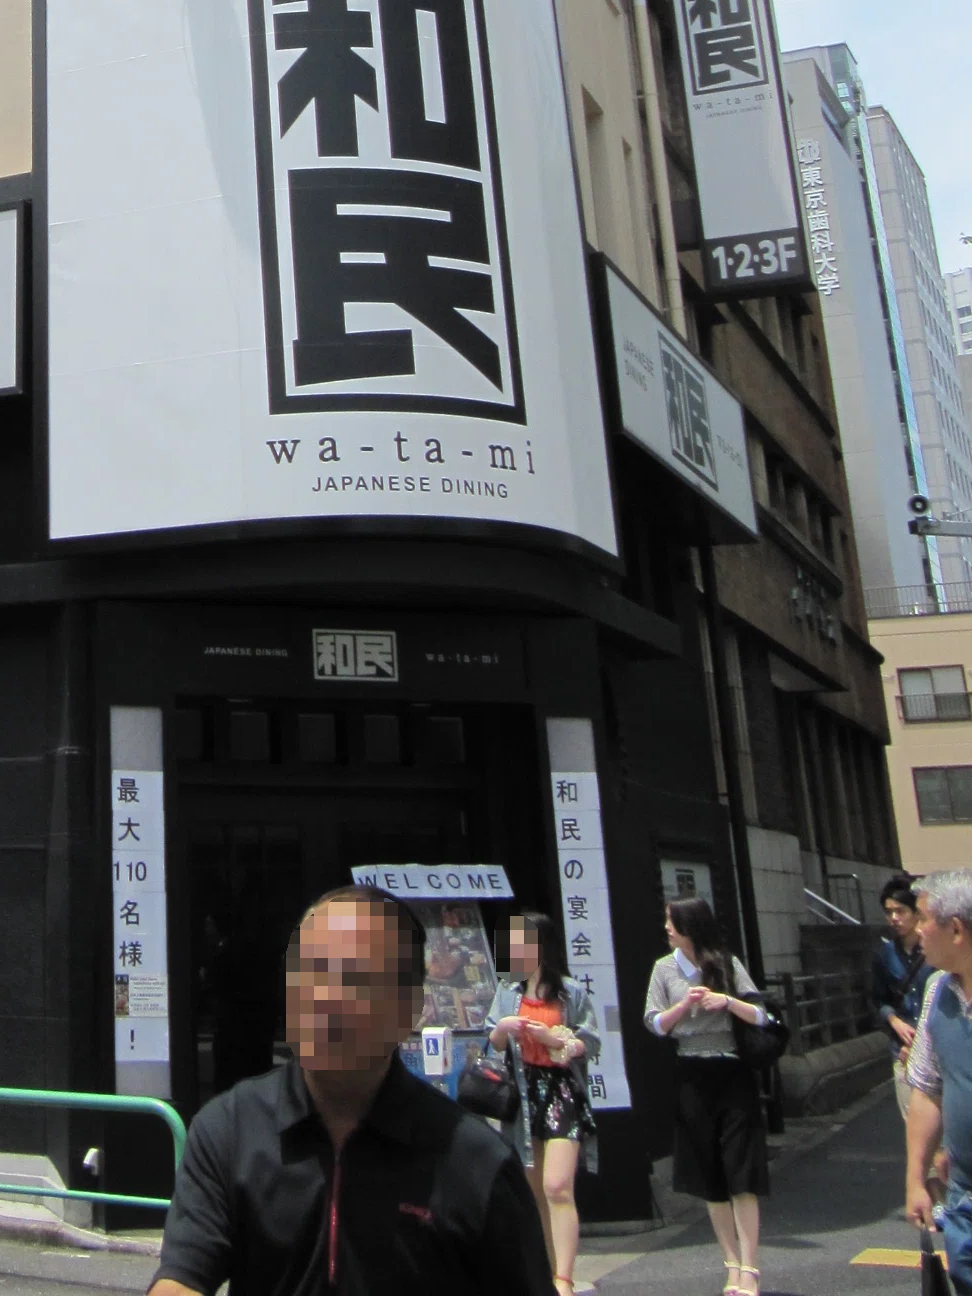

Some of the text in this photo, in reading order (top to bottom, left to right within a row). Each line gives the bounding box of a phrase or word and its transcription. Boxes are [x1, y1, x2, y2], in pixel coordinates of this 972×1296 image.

[800, 166, 841, 296] 東京歯科大学
[660, 347, 716, 476] 和民
[266, 430, 536, 475] wa-ta-mi
[311, 475, 509, 499] JAPANESE DINING
[316, 633, 396, 677] 和民
